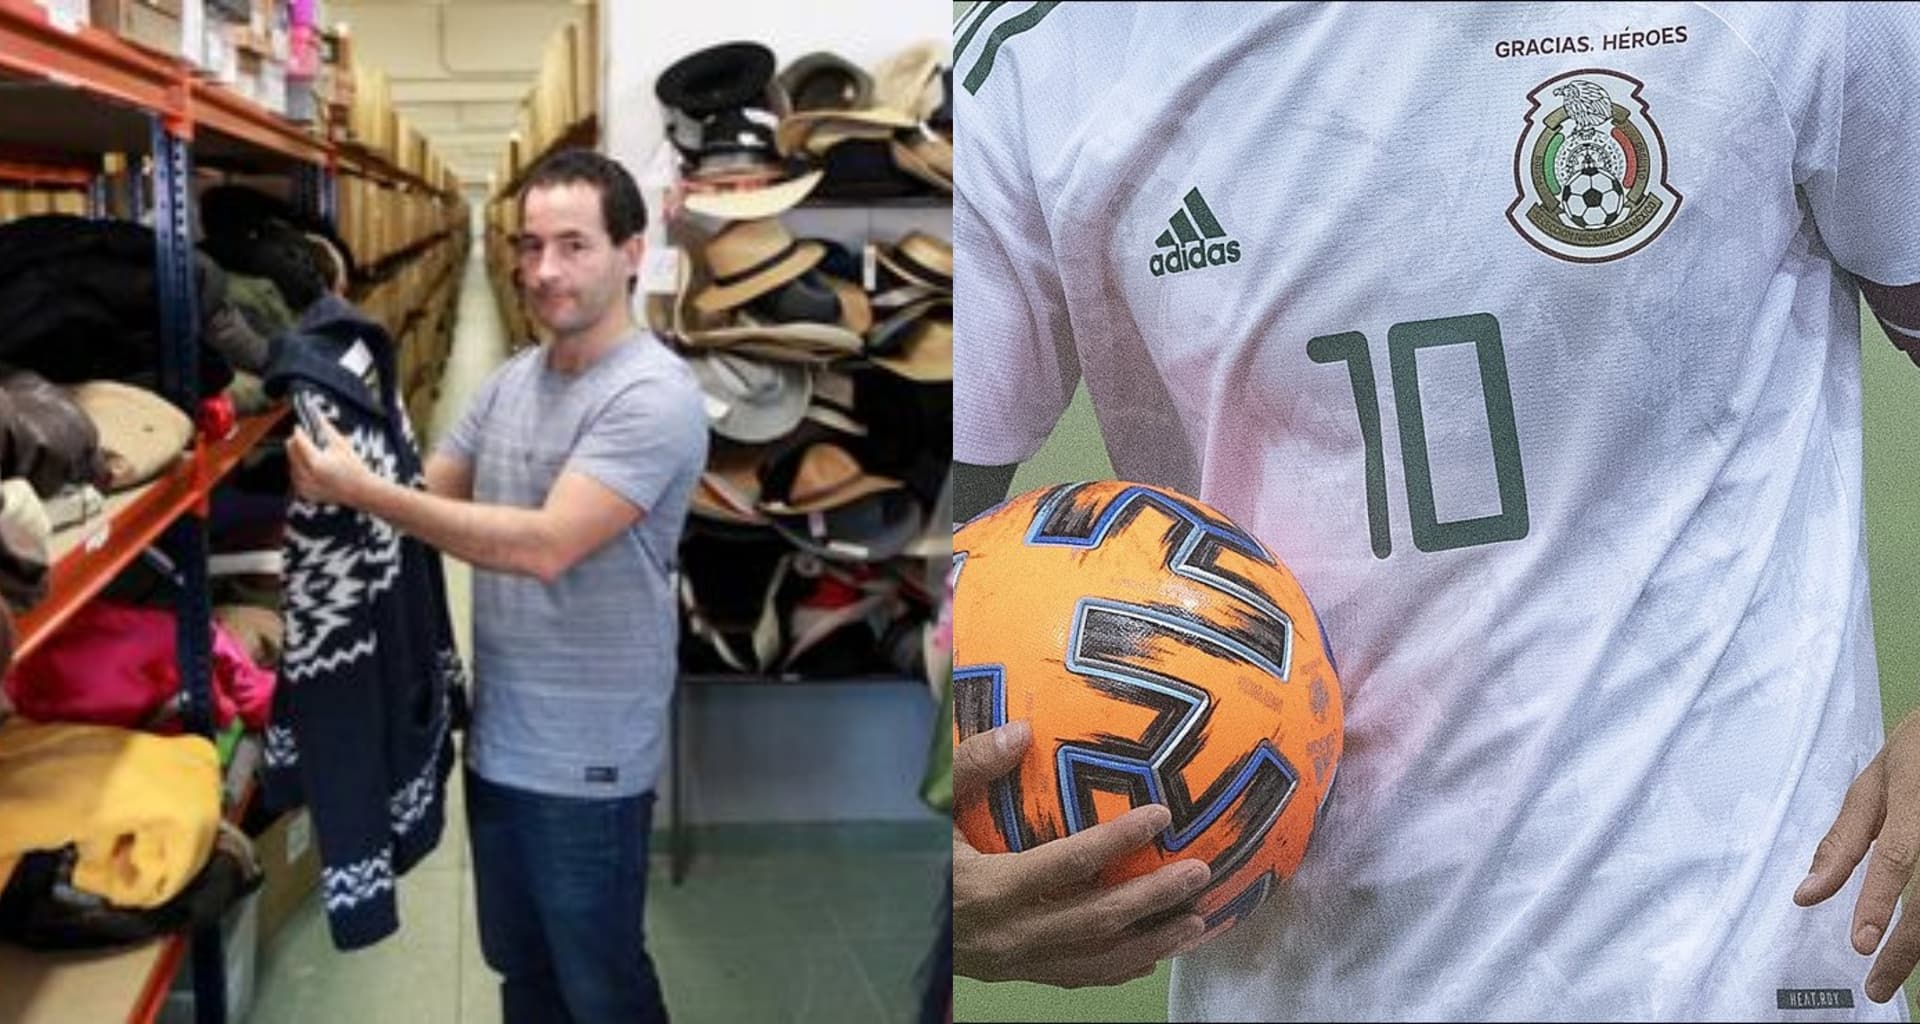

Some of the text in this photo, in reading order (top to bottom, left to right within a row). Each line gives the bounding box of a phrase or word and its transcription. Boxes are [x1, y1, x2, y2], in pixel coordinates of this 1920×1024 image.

[1603, 25, 1687, 51] HÉROES
[1149, 239, 1241, 277] adidas
[1306, 312, 1530, 560] 10
